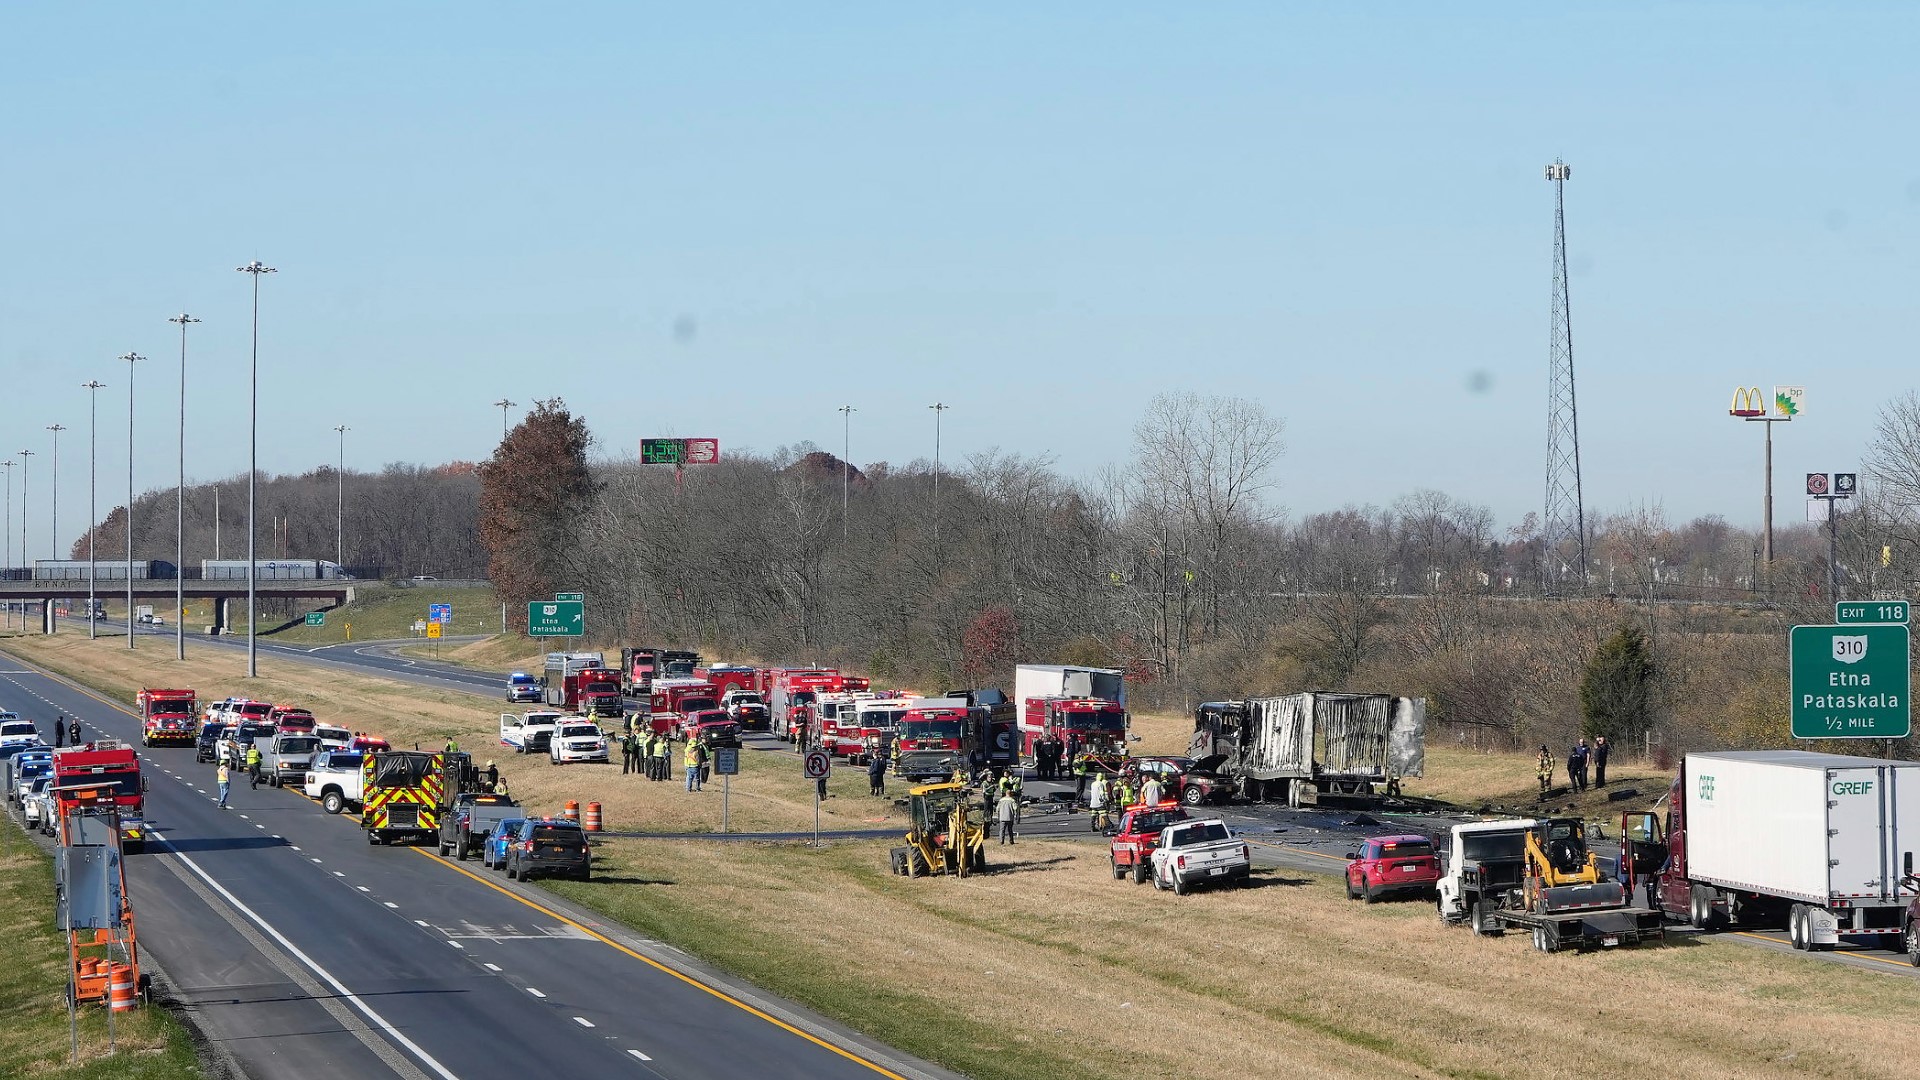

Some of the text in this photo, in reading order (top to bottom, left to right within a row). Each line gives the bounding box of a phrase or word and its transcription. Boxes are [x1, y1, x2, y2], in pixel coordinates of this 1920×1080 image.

[1790, 388, 1803, 397] bp
[1842, 606, 1903, 619] EXIT 118
[1836, 641, 1863, 655] 310
[1829, 672, 1871, 687] Etna
[1803, 693, 1898, 708] Pataskala
[1848, 718, 1875, 728] MILE
[1698, 774, 1715, 801] GREIF
[1832, 781, 1874, 796] GREIF
